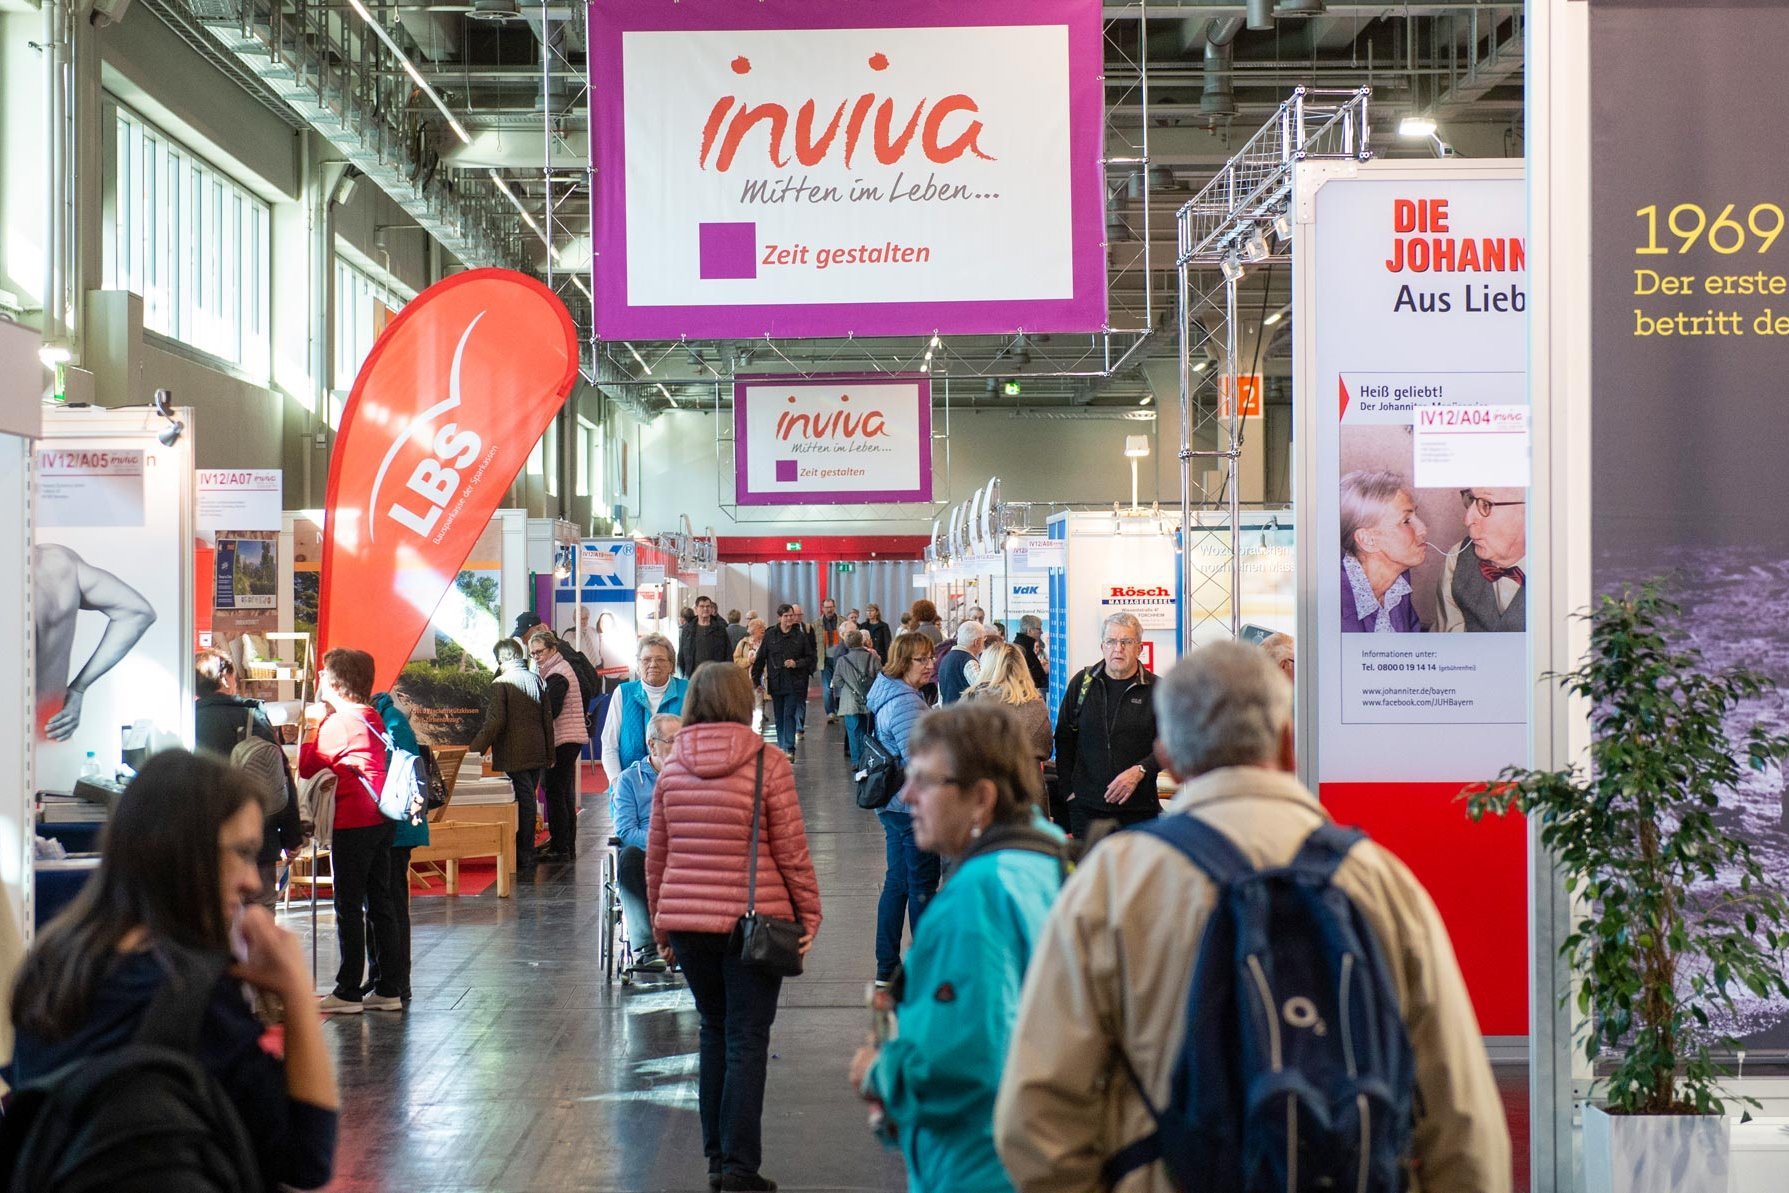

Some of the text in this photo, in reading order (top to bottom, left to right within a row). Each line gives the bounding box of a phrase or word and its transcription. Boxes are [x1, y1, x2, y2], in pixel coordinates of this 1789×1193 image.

[699, 52, 998, 172] inviva
[740, 172, 999, 204] Mitten im Leben...
[1393, 198, 1450, 233] DIE
[1635, 203, 1784, 255] 1969
[762, 242, 930, 269] Zeit gestalten
[1385, 237, 1525, 273] JOHANN
[1634, 269, 1787, 295] Der erste
[1393, 284, 1525, 313] Aus Lieb
[1634, 308, 1789, 336] betritt de
[1360, 385, 1443, 400] Heiß geliebt!
[776, 394, 893, 441] inviva
[1360, 402, 1375, 411] Der
[1420, 410, 1491, 425] IV12/A04
[42, 453, 109, 468] IV12/A05
[791, 443, 831, 453] Mitten
[833, 443, 846, 453] im
[201, 473, 253, 485] IV12/A07
[387, 422, 482, 538] LBS
[800, 467, 865, 478] Zeit gestalten
[433, 445, 498, 544] Bausparkasse der Sparkassen
[1013, 586, 1038, 594] VdK
[1110, 586, 1170, 597] Rösch
[1361, 650, 1413, 658] Informationen
[1362, 687, 1456, 696] www.johanniter.de/bayern
